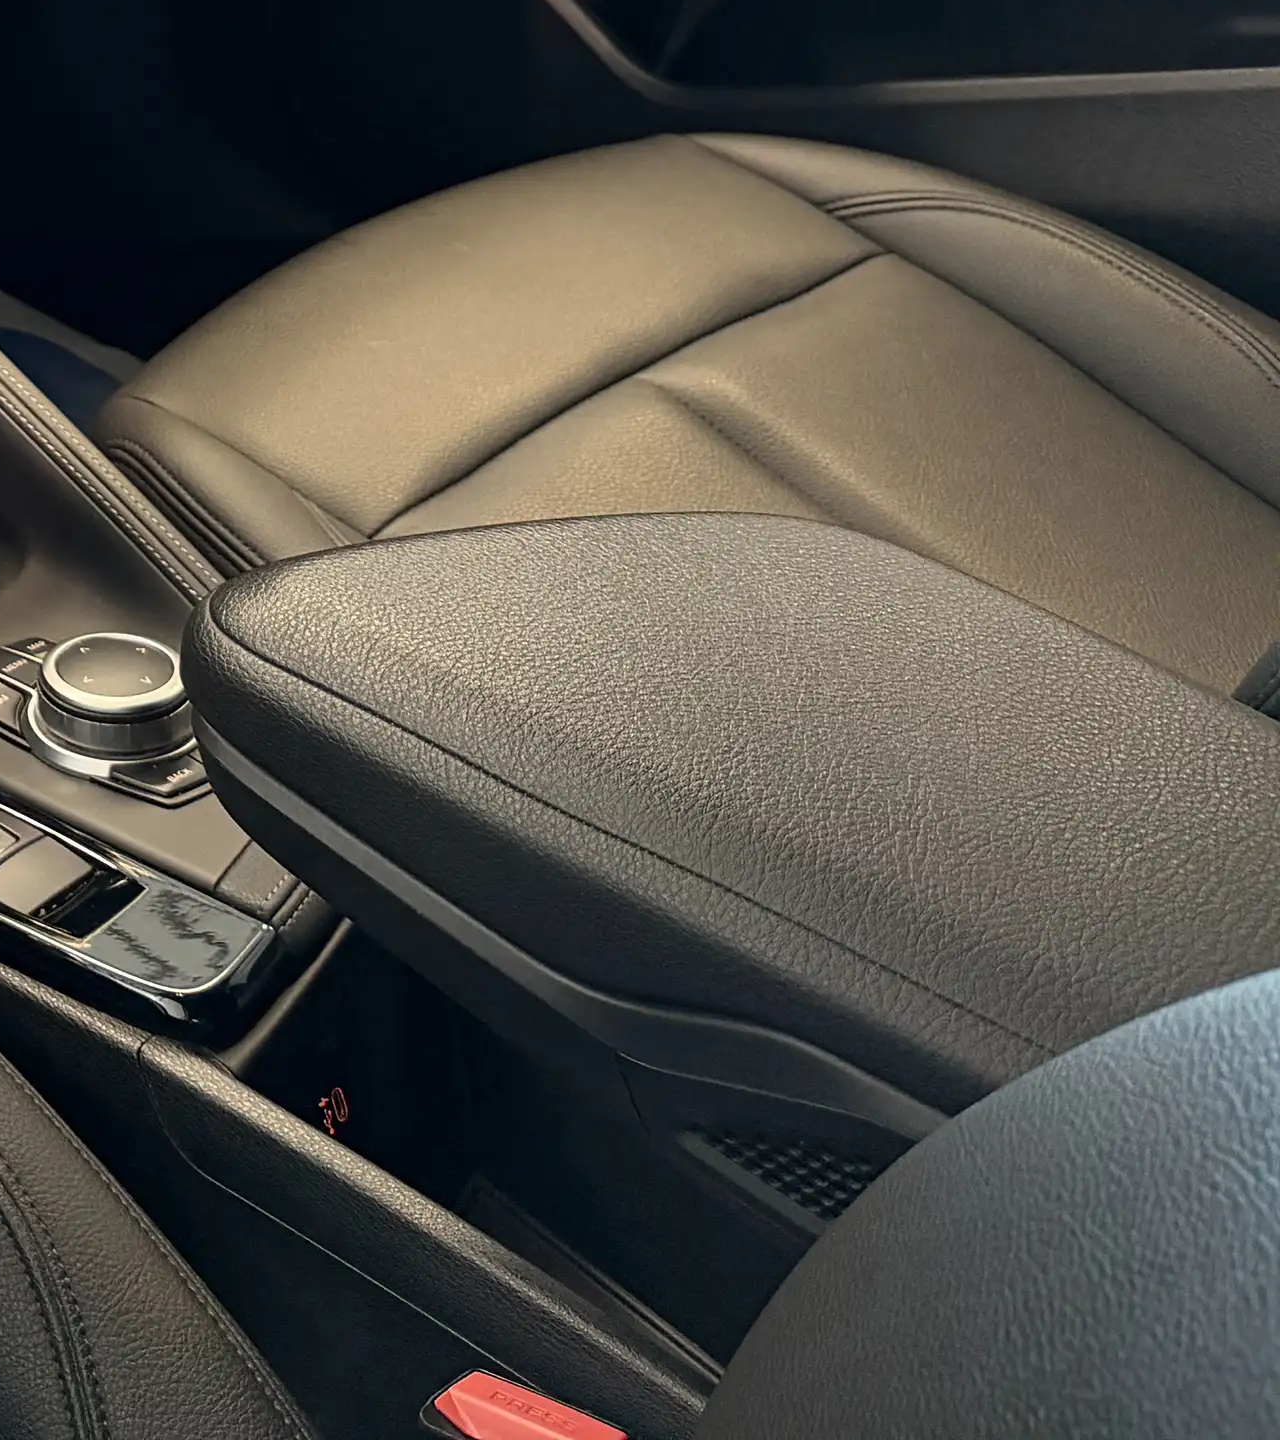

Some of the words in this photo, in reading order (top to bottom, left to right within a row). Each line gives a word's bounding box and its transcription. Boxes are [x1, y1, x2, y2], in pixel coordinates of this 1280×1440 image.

[1, 658, 28, 673] MENU
[166, 767, 194, 784] BACK
[489, 1390, 577, 1431] PRESS
